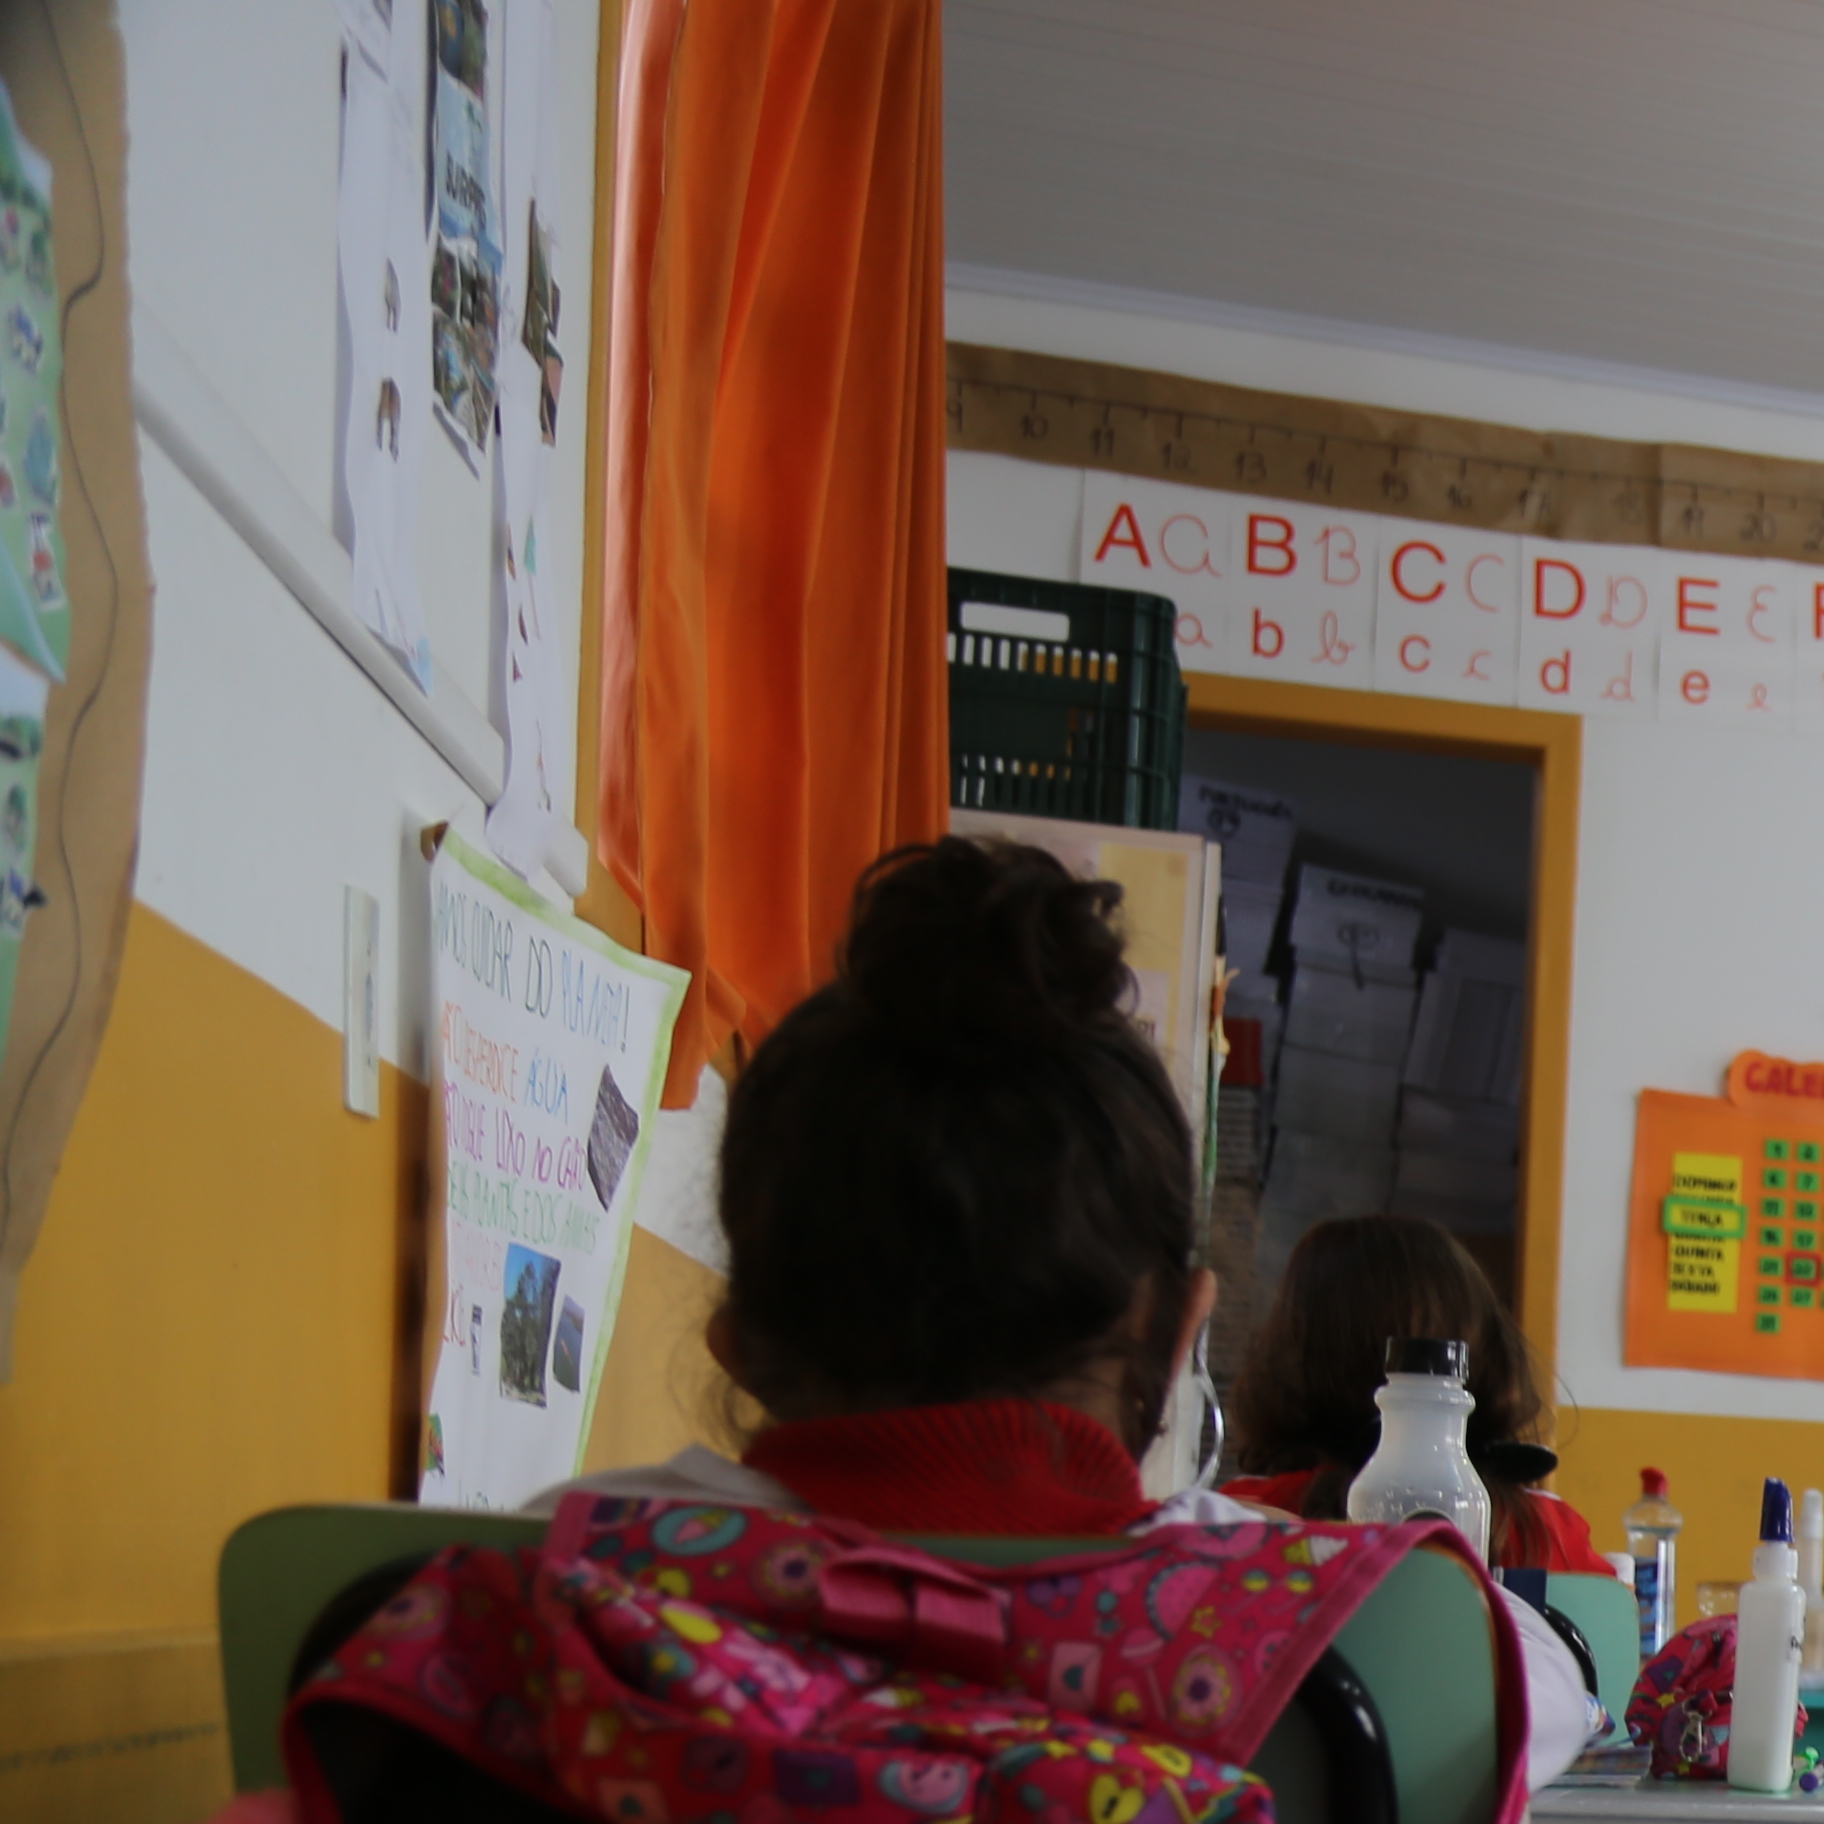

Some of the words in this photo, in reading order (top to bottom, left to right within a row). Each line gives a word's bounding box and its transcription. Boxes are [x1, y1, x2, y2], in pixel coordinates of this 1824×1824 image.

[1094, 503, 1152, 569] A
[1246, 511, 1298, 578] B
[1533, 558, 1587, 622] D
[1676, 577, 1721, 636] E
[1252, 606, 1285, 660] b
[1540, 648, 1572, 696] d
[1680, 669, 1711, 706] e
[525, 936, 553, 1019] DO
